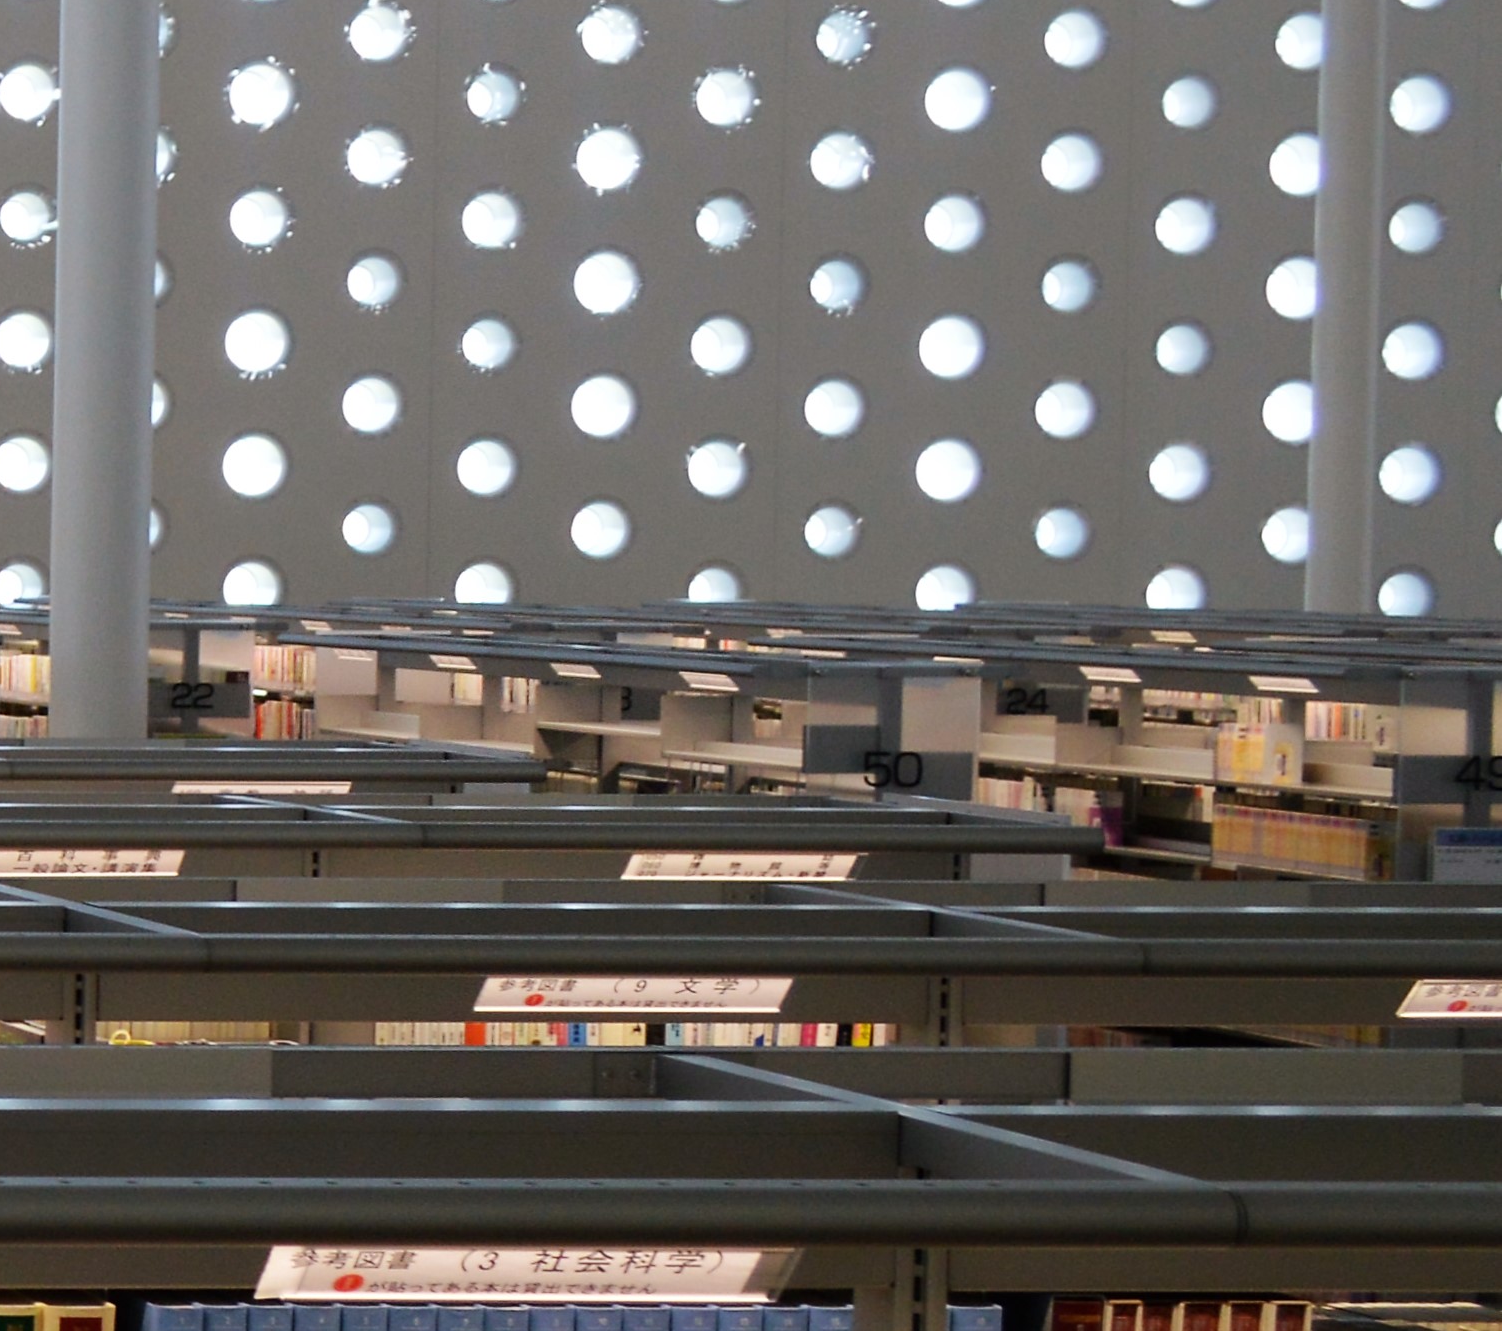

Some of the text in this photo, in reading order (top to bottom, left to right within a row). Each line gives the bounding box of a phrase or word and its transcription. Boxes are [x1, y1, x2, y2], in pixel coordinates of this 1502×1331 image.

[171, 683, 213, 709] 22
[1007, 689, 1048, 715] 24
[864, 752, 923, 789] 50
